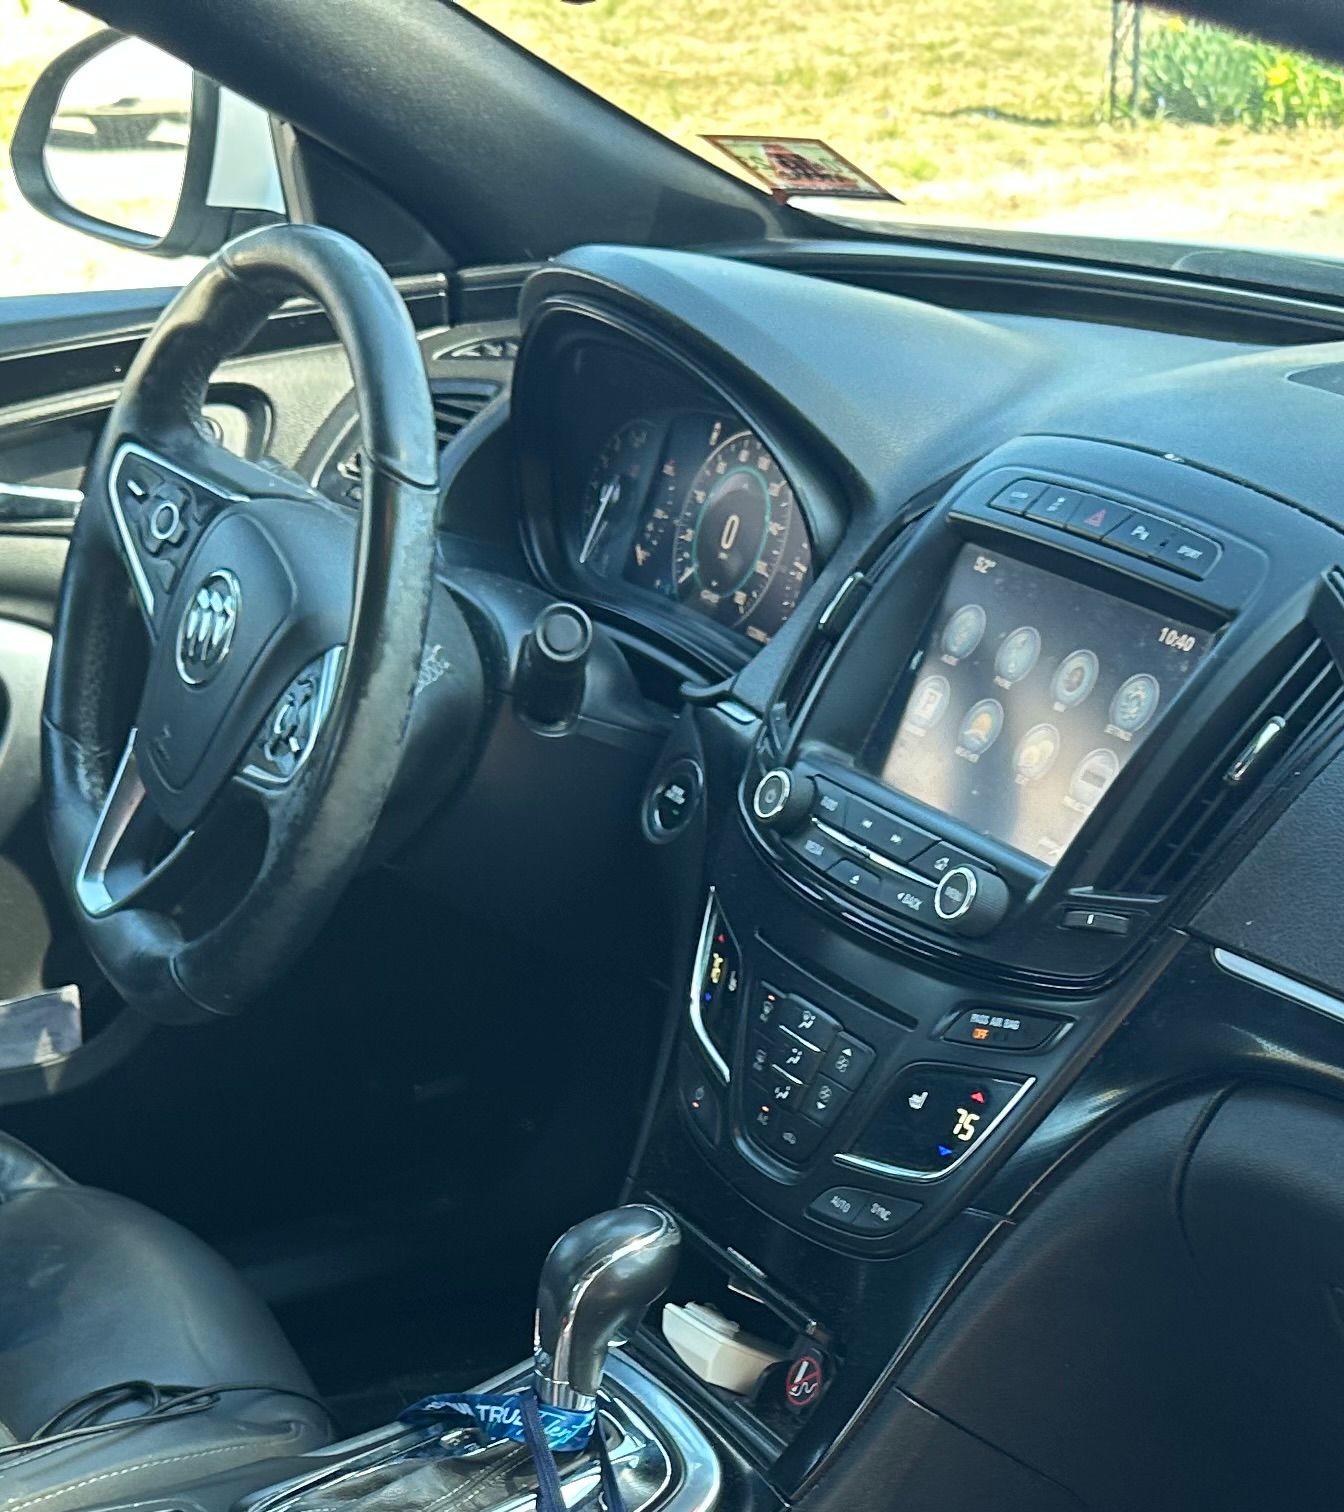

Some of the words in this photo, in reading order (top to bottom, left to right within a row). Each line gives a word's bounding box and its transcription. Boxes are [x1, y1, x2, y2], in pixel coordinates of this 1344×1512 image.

[1158, 627, 1197, 653] 10:40
[903, 892, 924, 911] BACK
[953, 1107, 980, 1142] 75
[830, 1195, 851, 1213] AUTO
[870, 1202, 892, 1222] SYNC
